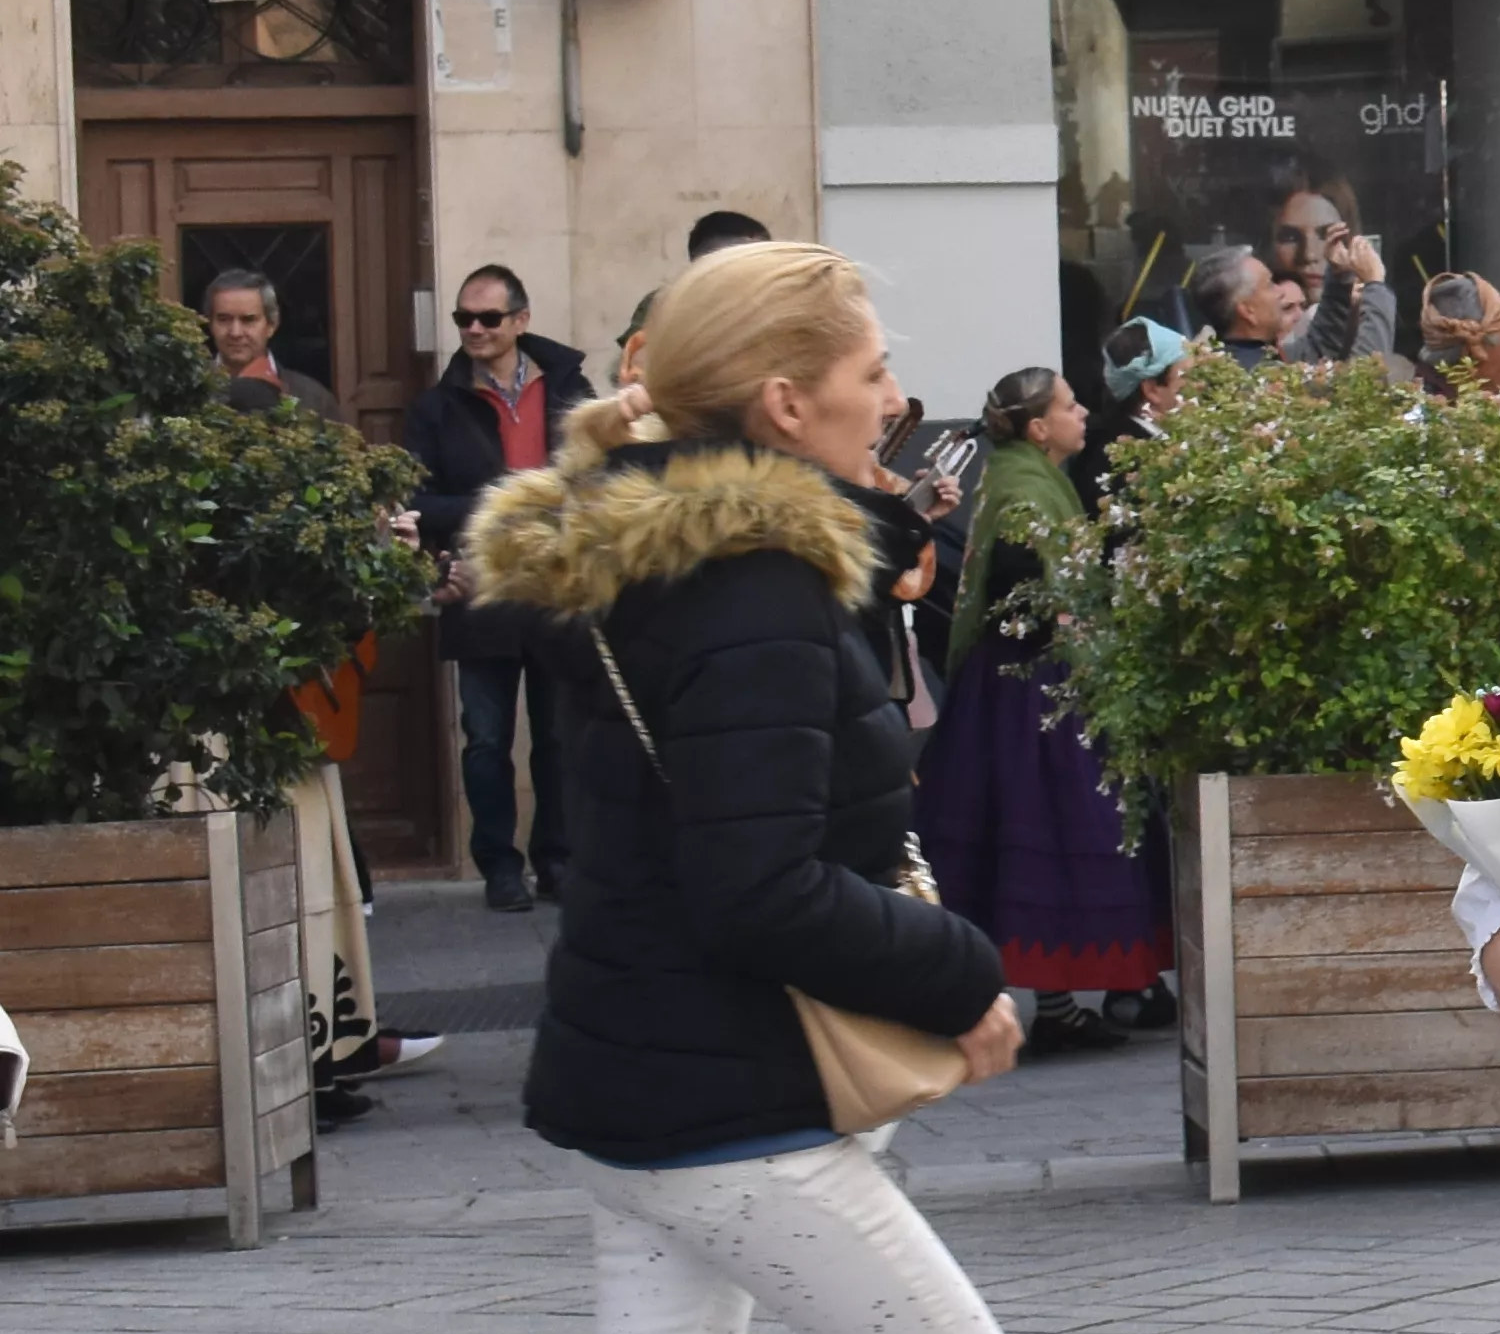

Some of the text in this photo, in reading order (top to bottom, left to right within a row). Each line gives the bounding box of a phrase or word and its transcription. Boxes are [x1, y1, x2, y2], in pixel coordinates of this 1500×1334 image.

[1132, 95, 1276, 118] NUEVA GHD
[1359, 93, 1425, 135] ghd
[1168, 116, 1296, 138] DUET STYLE
